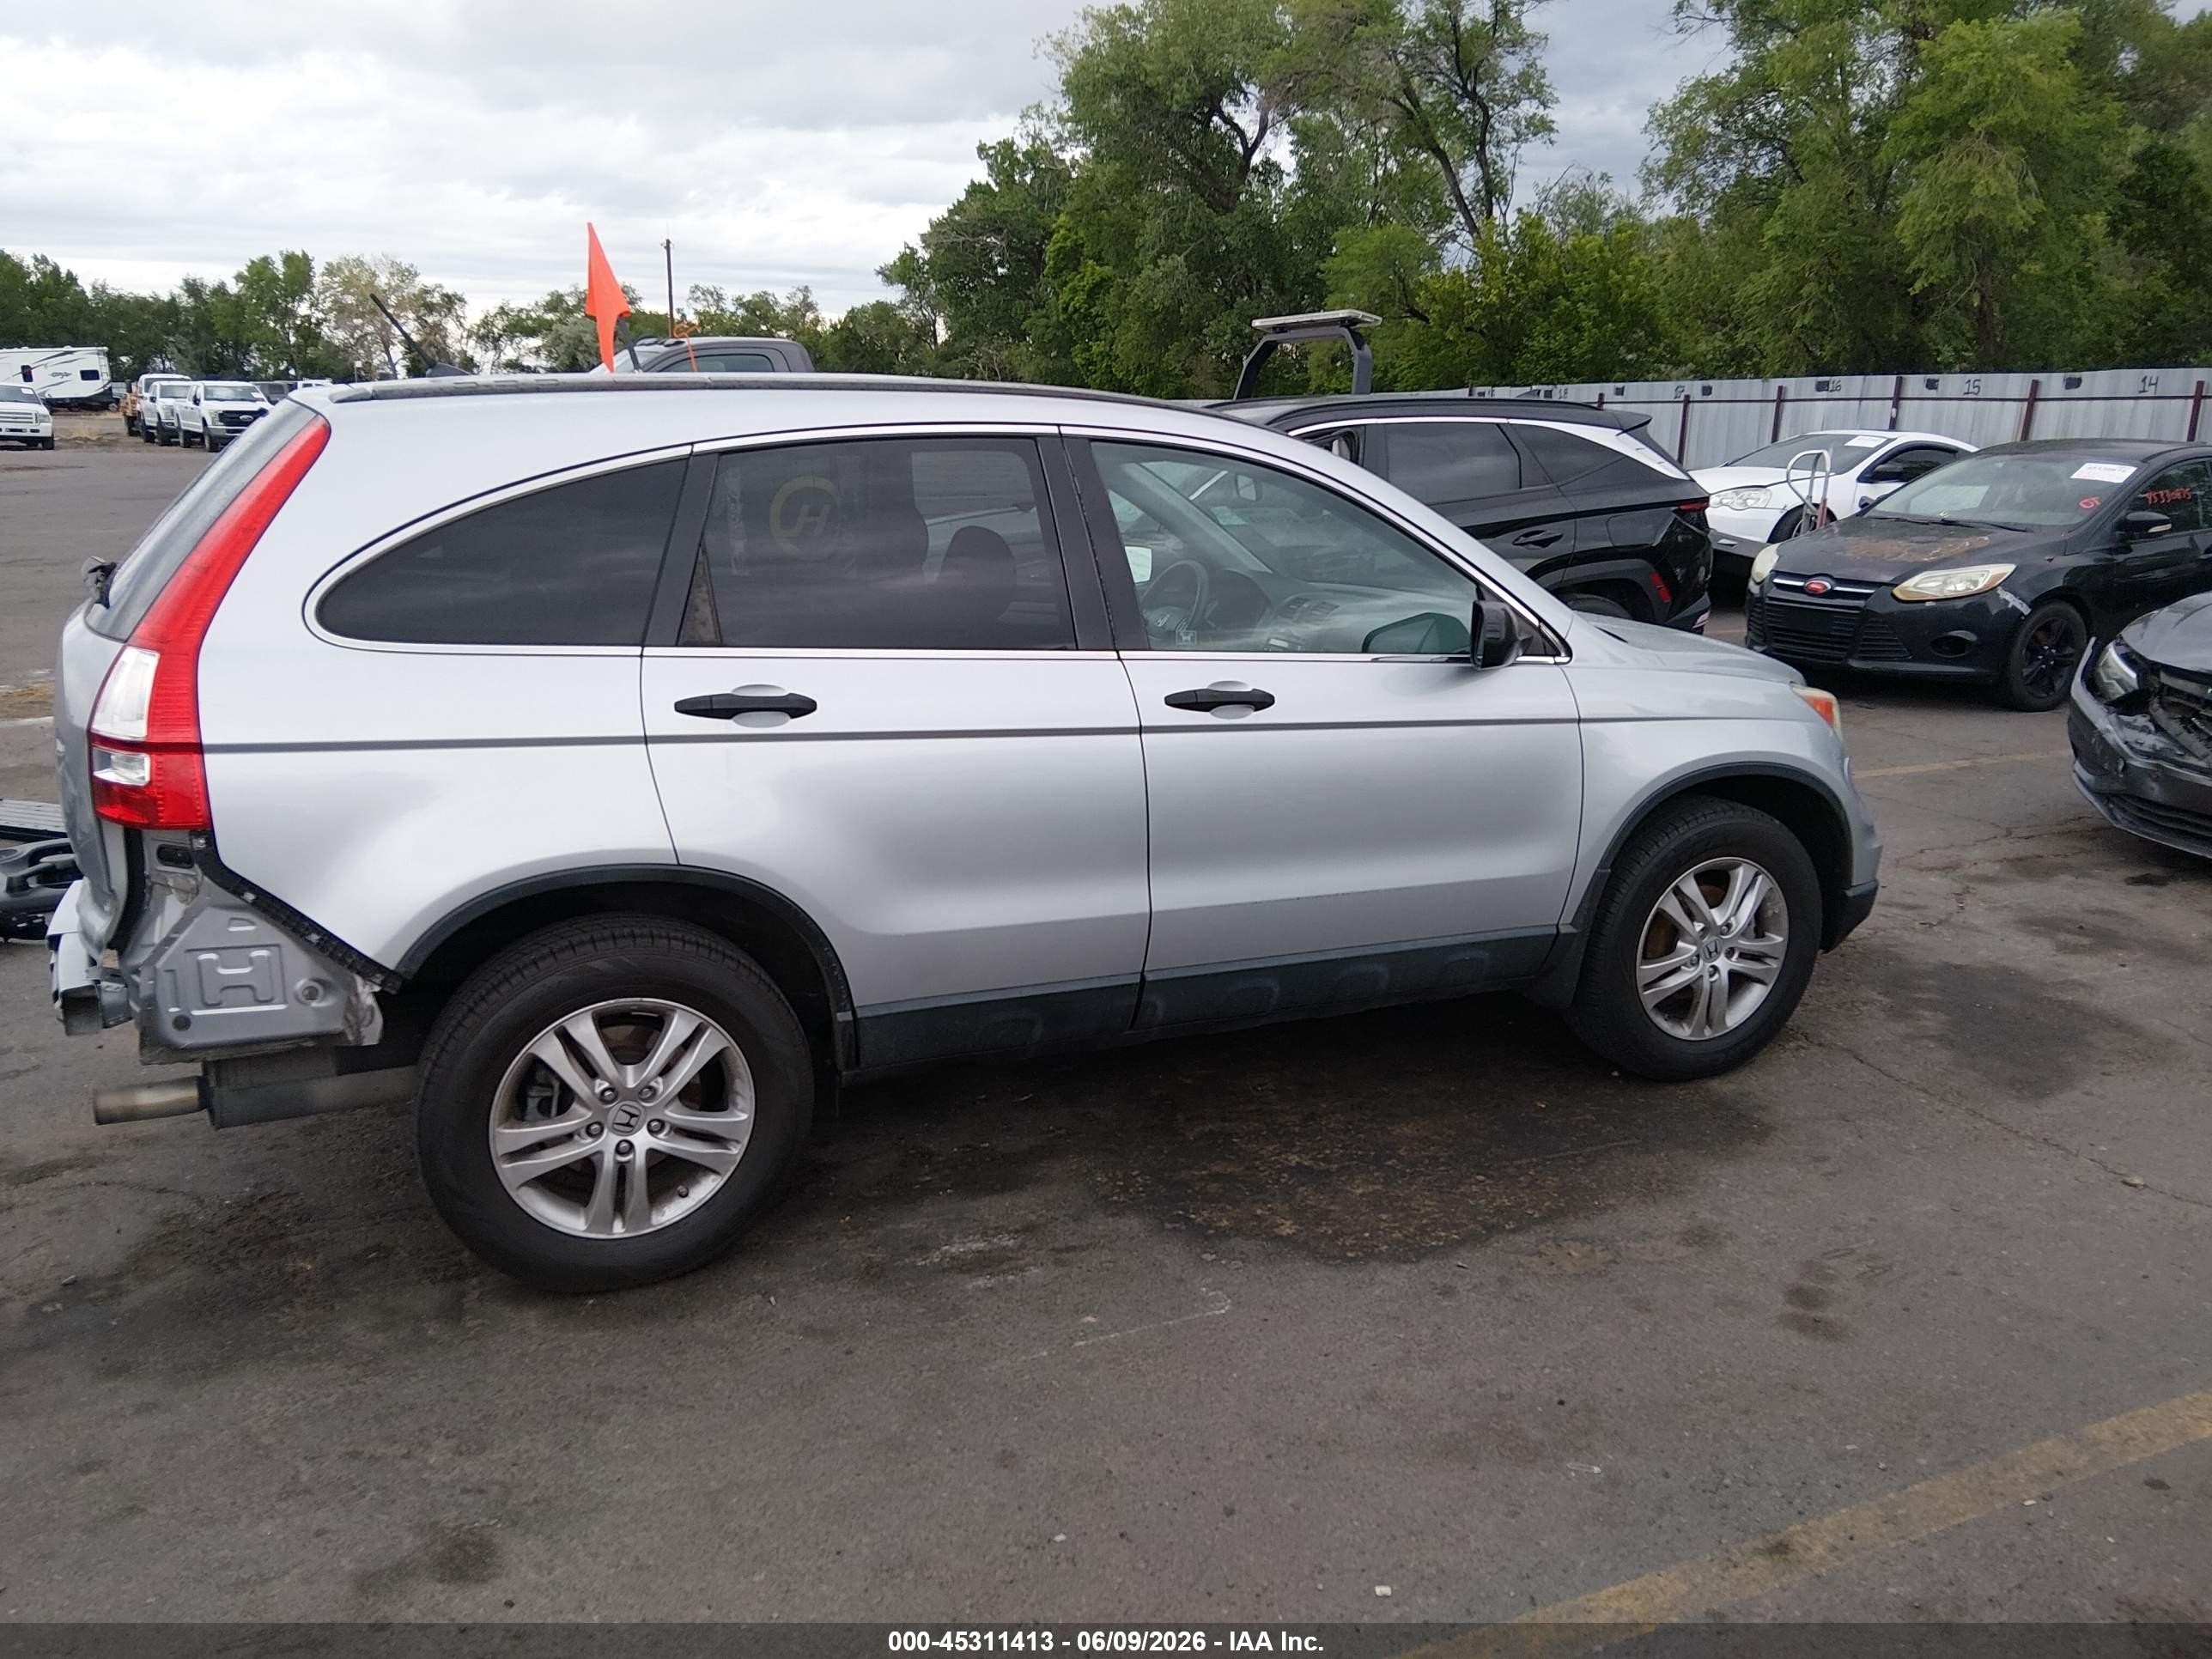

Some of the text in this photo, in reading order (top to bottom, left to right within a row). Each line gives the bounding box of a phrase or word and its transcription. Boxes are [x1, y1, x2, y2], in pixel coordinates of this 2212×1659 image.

[1828, 380, 1842, 392] 16
[1963, 378, 1982, 396] 15
[2138, 375, 2160, 398] 14
